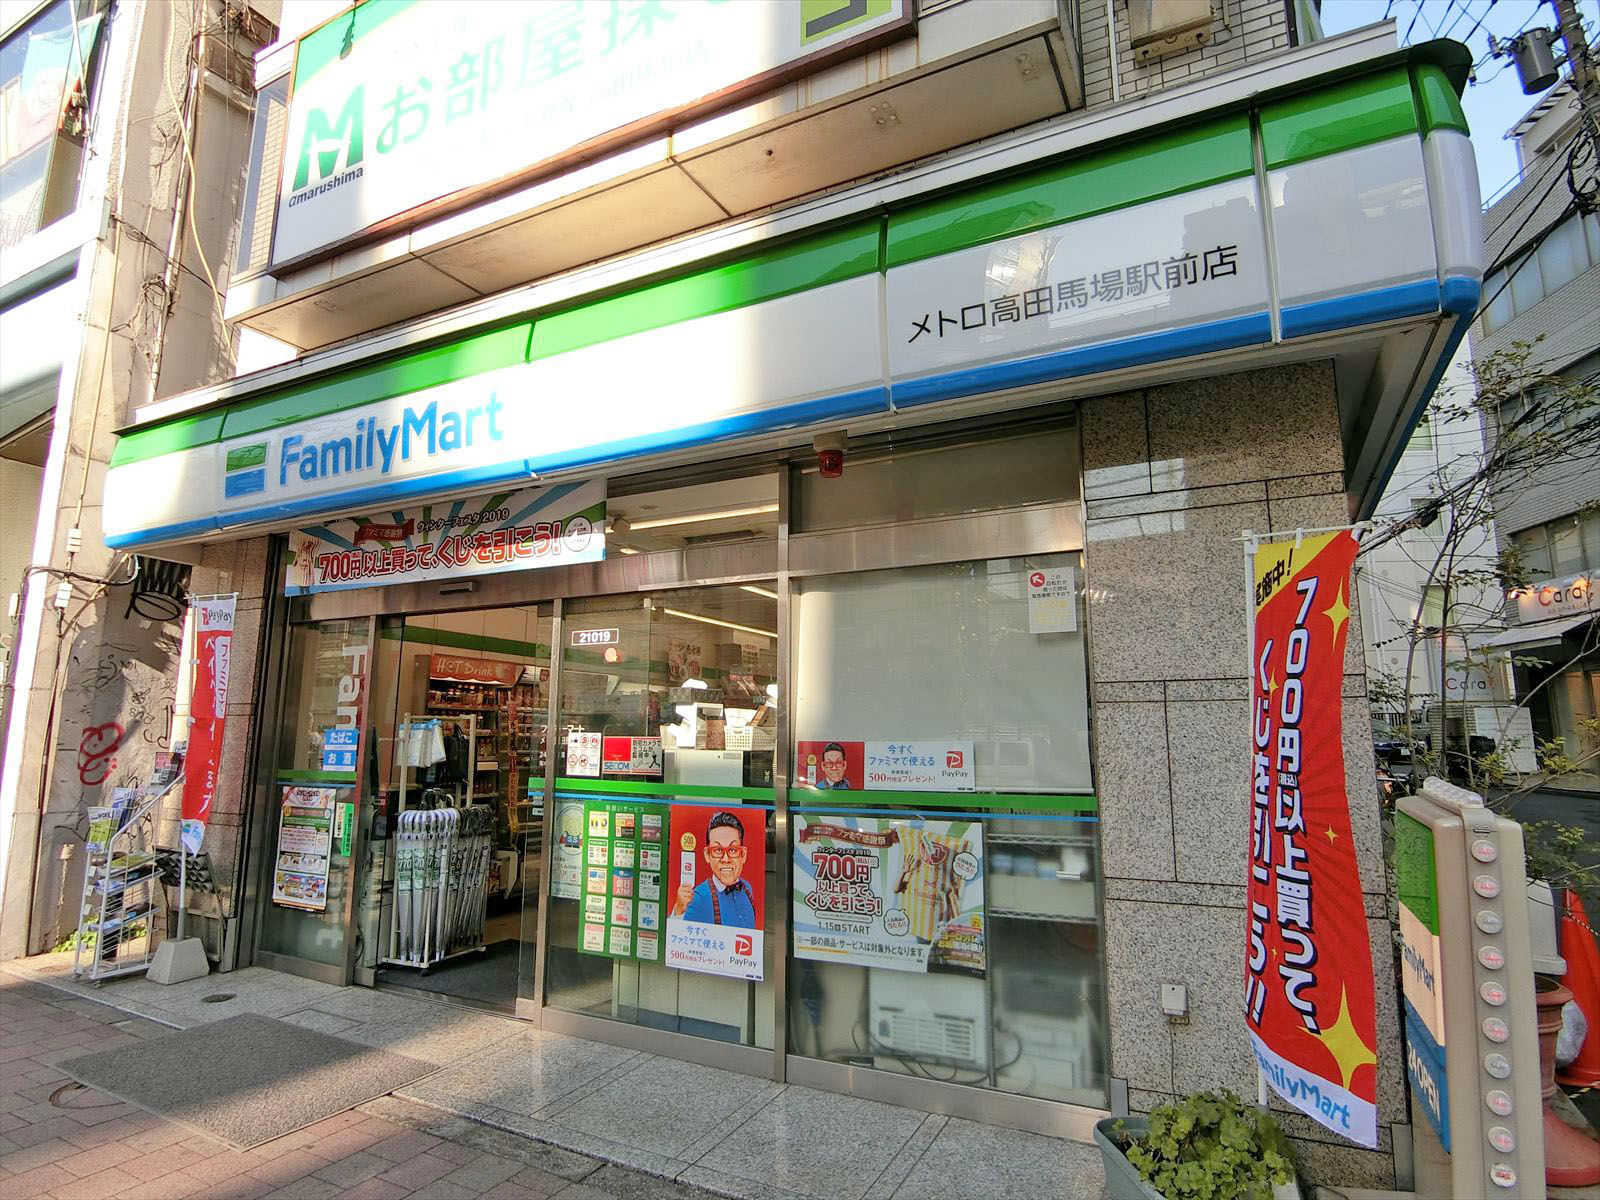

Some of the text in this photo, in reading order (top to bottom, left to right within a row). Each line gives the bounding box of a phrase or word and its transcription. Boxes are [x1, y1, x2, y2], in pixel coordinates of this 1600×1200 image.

[374, 0, 729, 155] お部屋探
[908, 244, 1238, 344] メトロ高田馬場駅前店
[279, 390, 504, 487] FamilyMart
[482, 508, 510, 526] 2019
[207, 608, 233, 624] PayPay
[579, 630, 611, 644] 21019
[436, 657, 494, 677] HOT Drink
[329, 731, 353, 744] たばこ
[887, 743, 913, 755] 今すぐ
[603, 761, 630, 771] SECOM
[868, 755, 936, 767] ファミマで使える
[941, 769, 969, 779] PayPay
[616, 888, 630, 896] ATM
[805, 892, 882, 917] くじを引こう!
[686, 925, 708, 937] 今すぐ
[670, 934, 726, 951] ファミマで使える
[729, 956, 758, 968] PayPay
